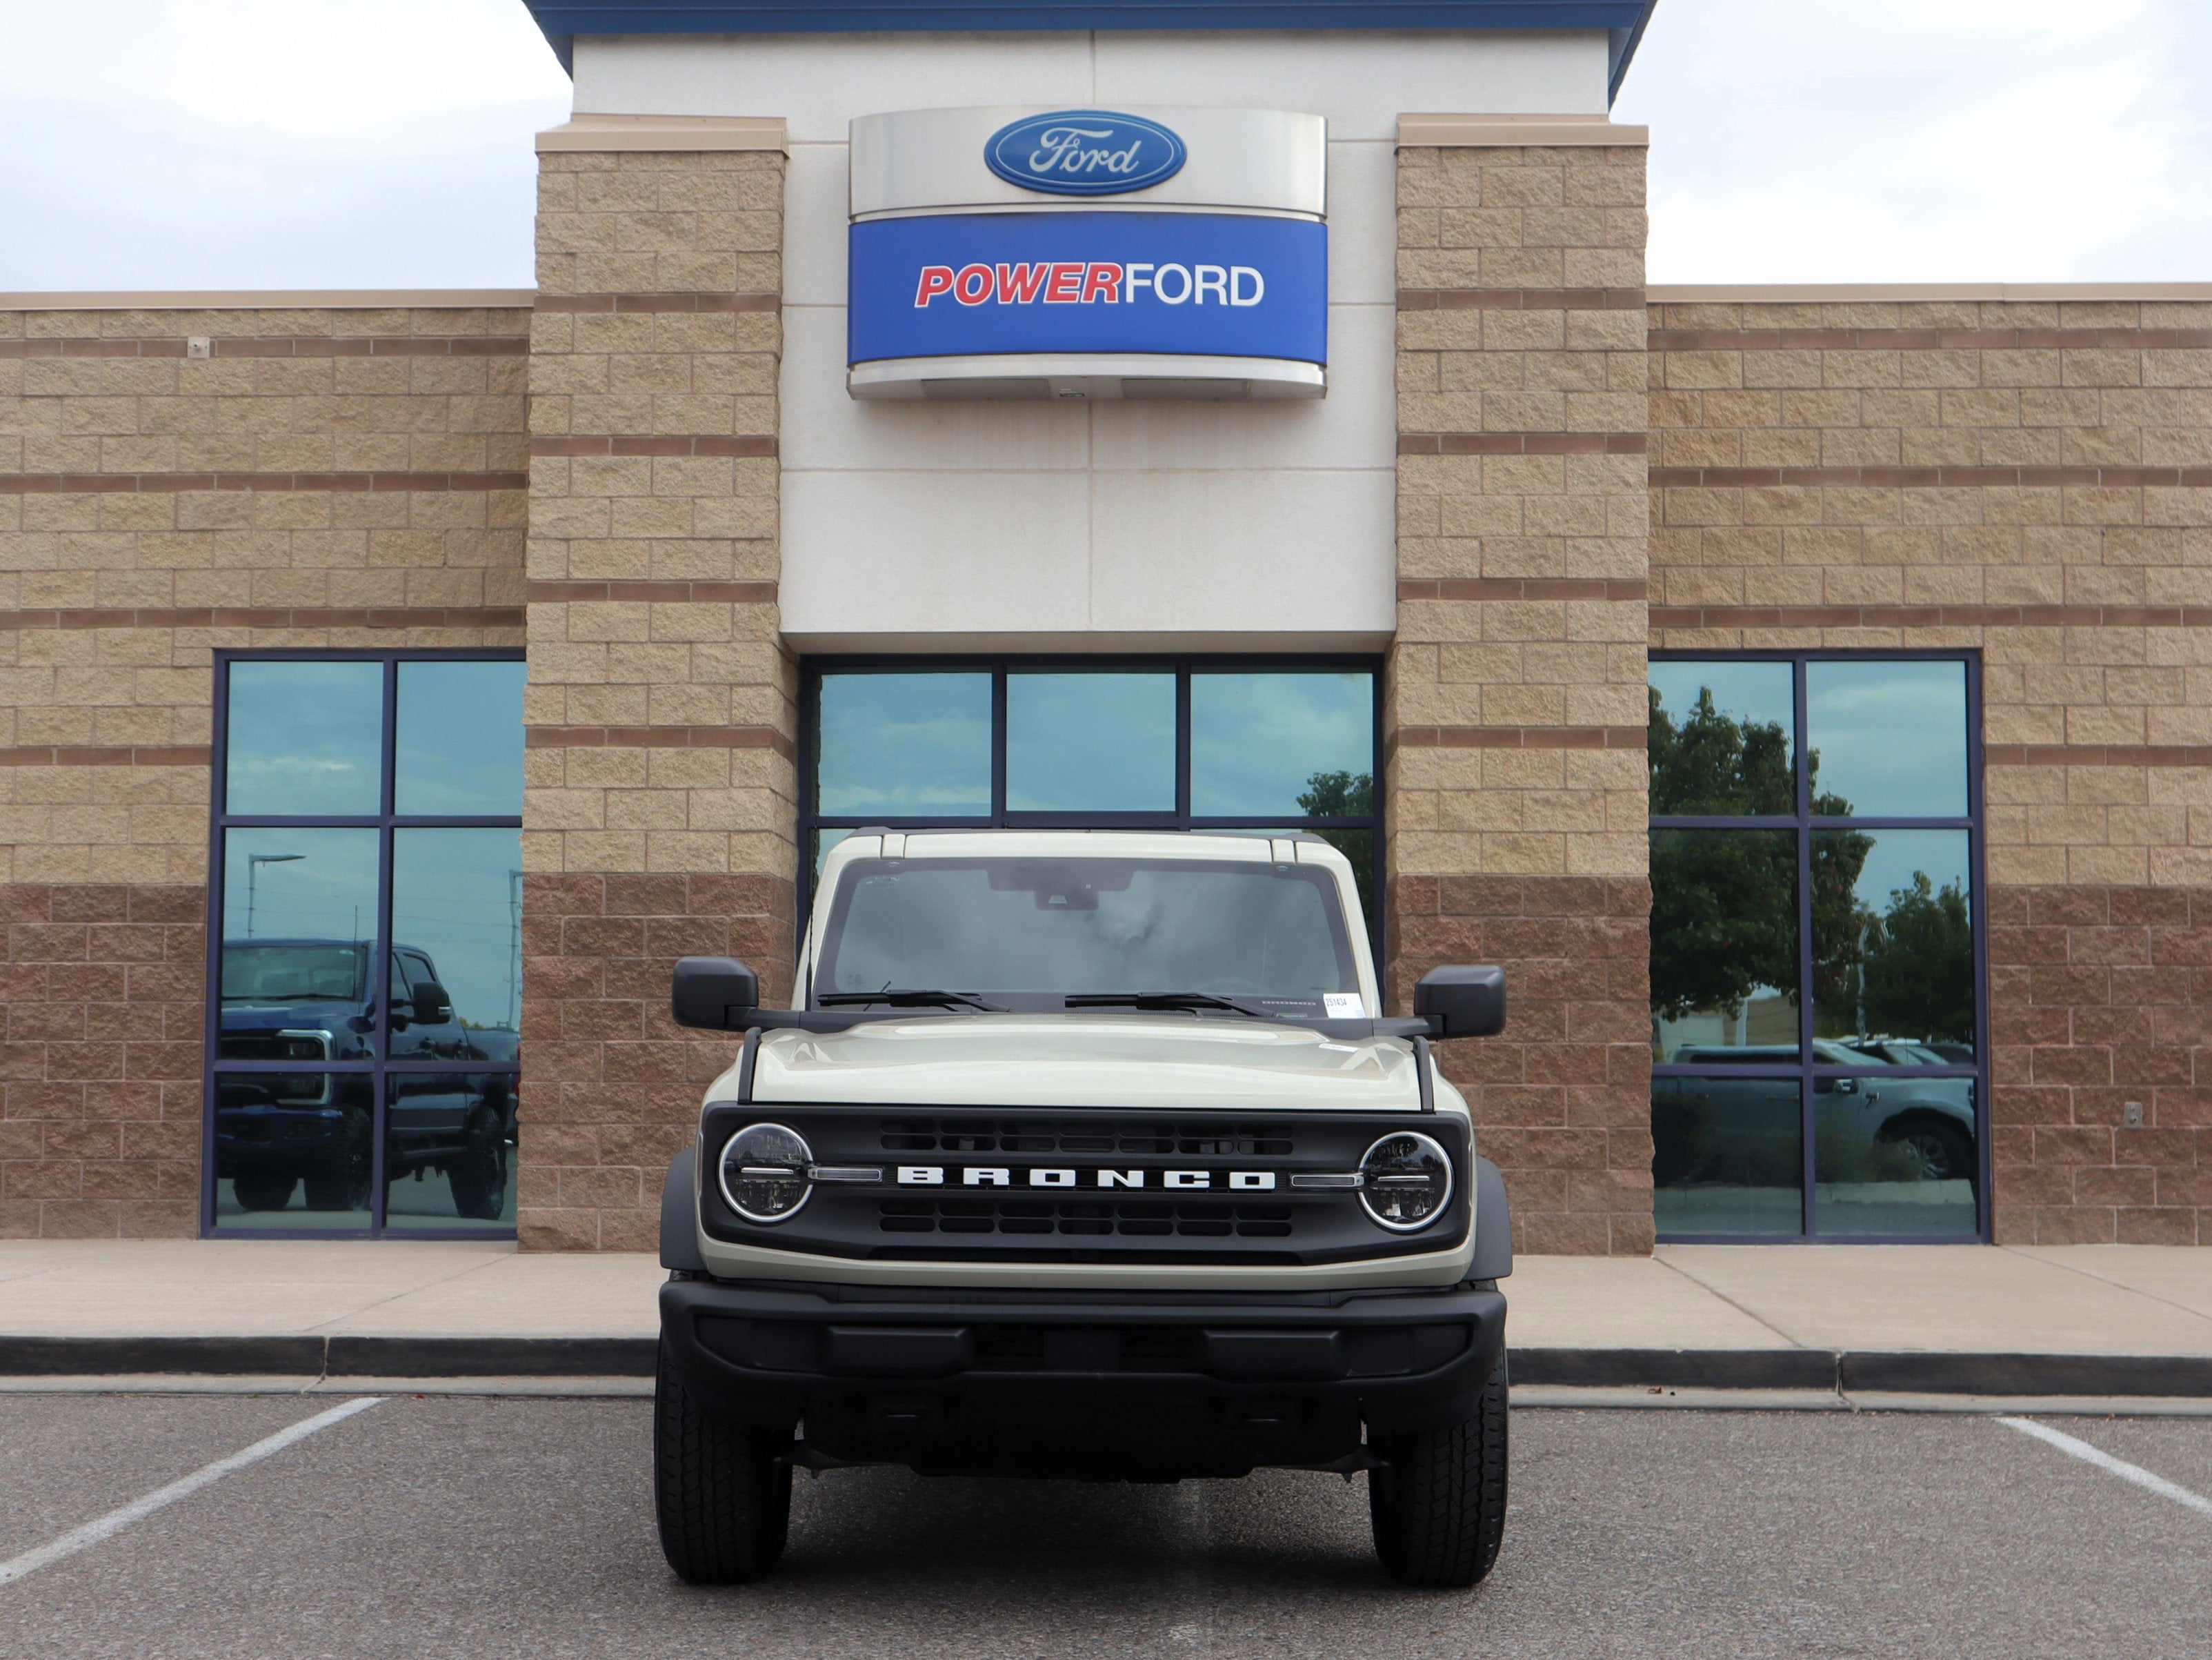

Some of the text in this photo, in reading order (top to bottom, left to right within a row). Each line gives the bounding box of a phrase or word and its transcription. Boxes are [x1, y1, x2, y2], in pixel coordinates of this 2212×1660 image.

[1028, 127, 1142, 174] Ford
[1325, 998, 1347, 1007] 251434
[897, 1166, 1275, 1189] BRONCO
